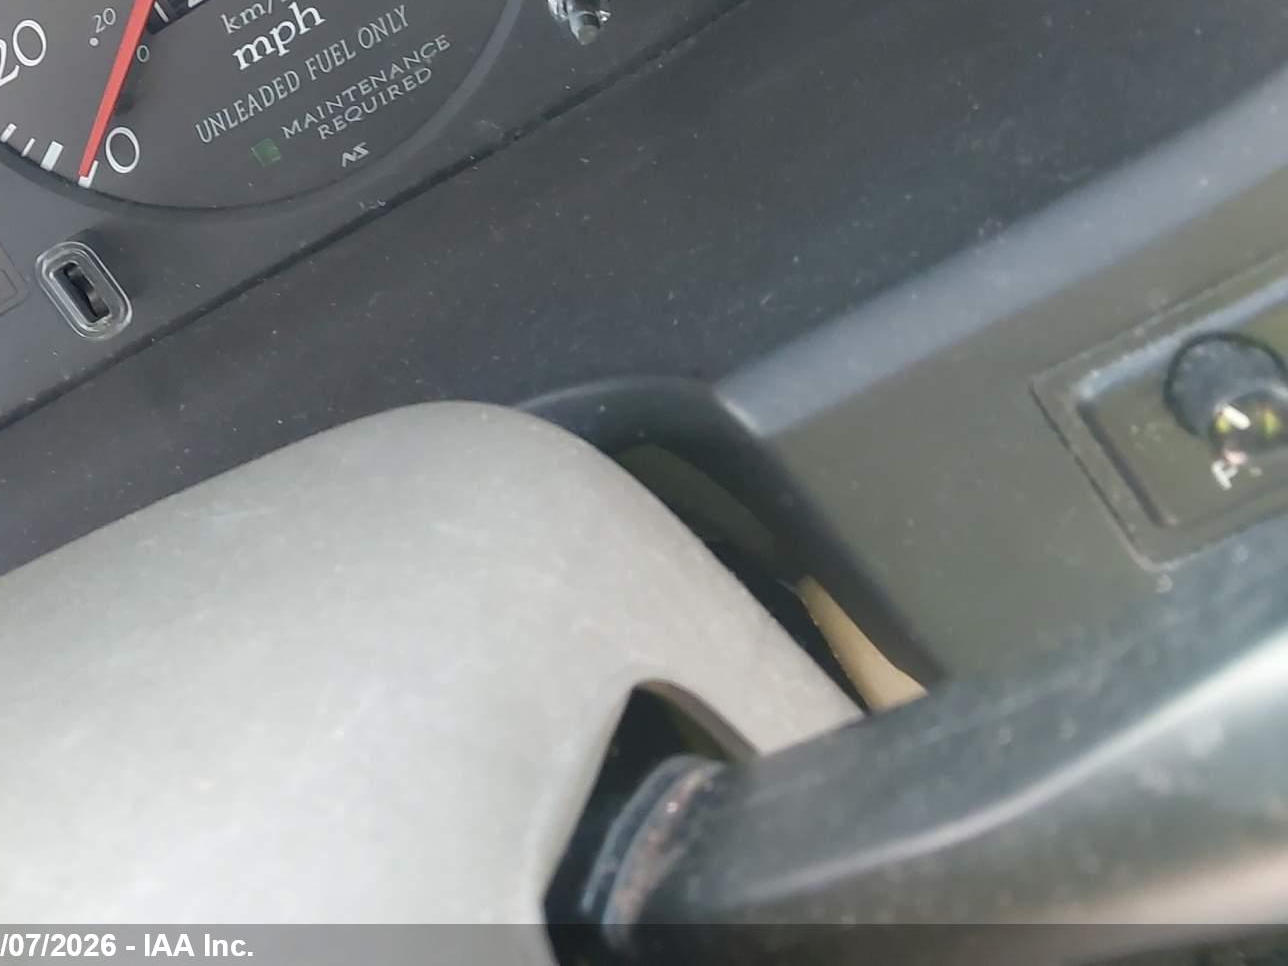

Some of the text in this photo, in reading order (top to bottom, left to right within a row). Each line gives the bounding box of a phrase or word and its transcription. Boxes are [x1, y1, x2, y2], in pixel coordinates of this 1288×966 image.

[93, 8, 116, 33] 20
[136, 45, 150, 63] 0
[232, 2, 326, 70] mph
[195, 4, 409, 143] UNLEADED FUEL ONLY
[281, 34, 451, 139] MAINTENANCE
[318, 67, 432, 139] REQUIRED
[105, 126, 140, 173] 0
